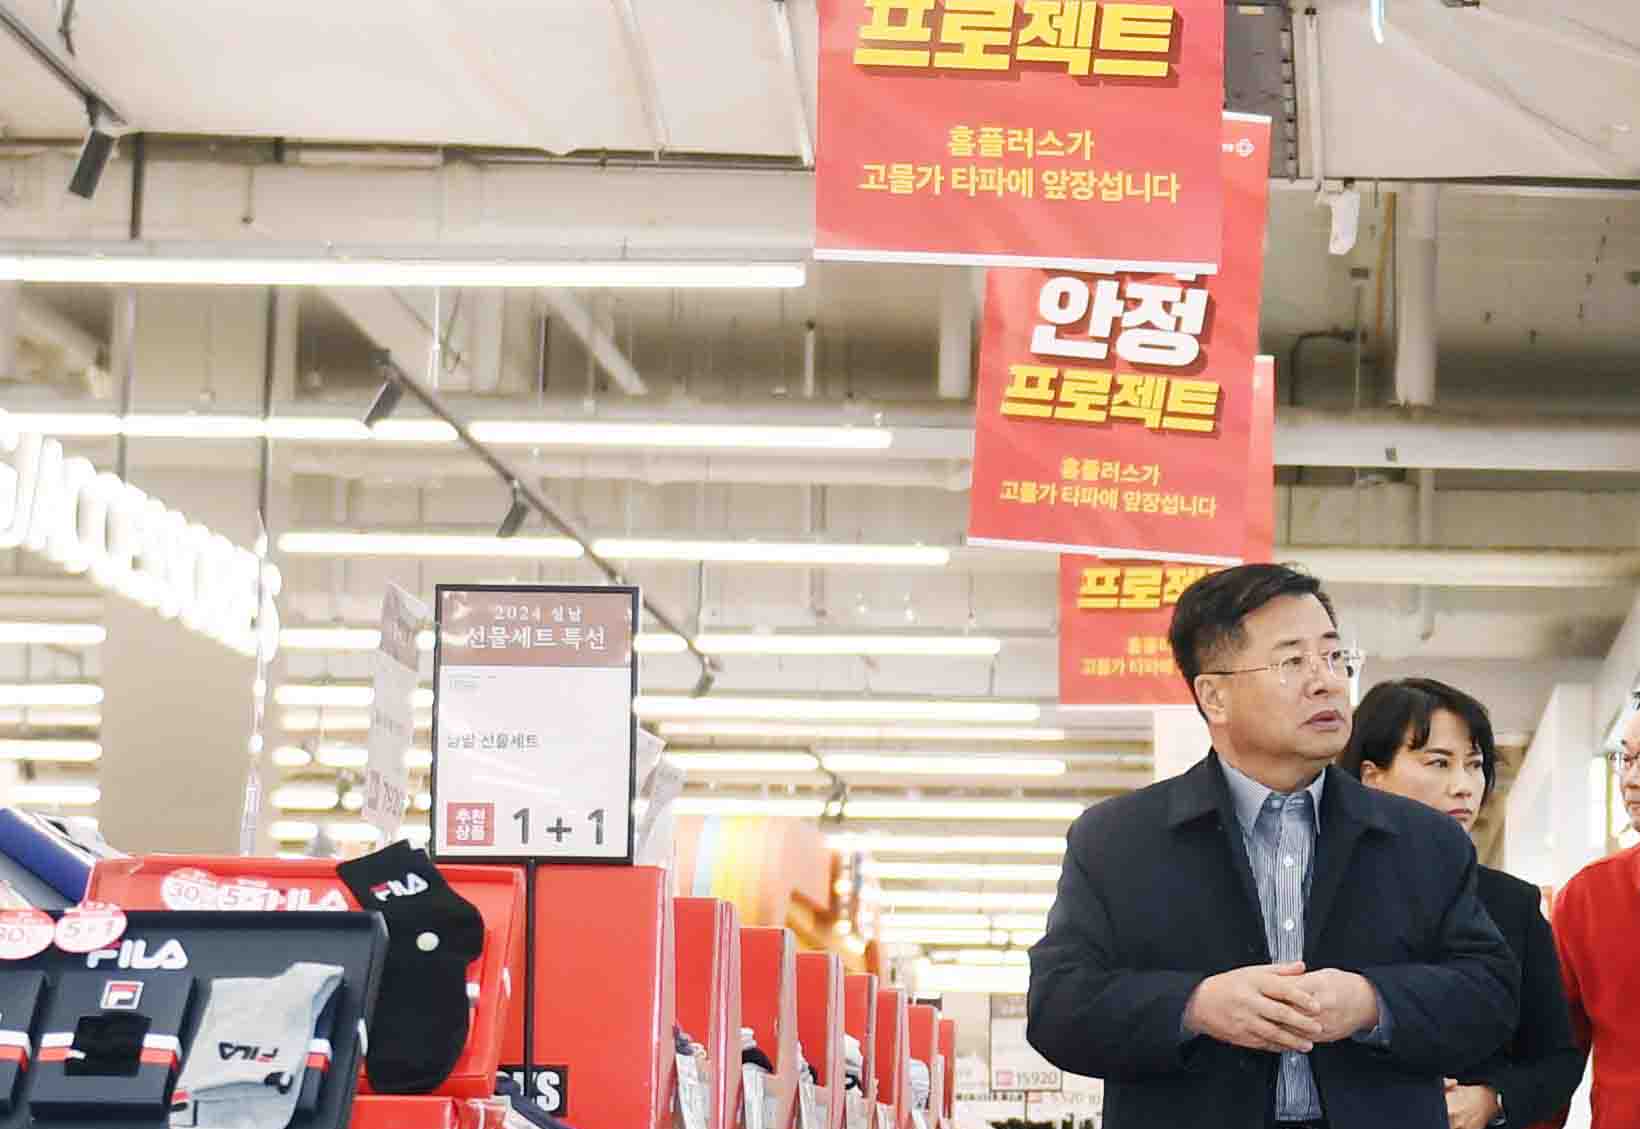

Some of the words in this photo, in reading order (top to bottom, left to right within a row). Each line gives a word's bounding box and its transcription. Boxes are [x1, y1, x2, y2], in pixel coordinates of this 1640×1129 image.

[854, 0, 1176, 78] 프로젝트
[948, 126, 1095, 160] 홈플러스가
[859, 163, 944, 196] 고물가
[951, 167, 1033, 199] 타파에
[1041, 168, 1180, 203] 앞장섭니다
[1030, 276, 1209, 367] 안정
[1000, 365, 1220, 433] 프로젝트
[1060, 456, 1160, 487] 홈플러스가
[999, 480, 1058, 505] 고물가
[1061, 485, 1119, 510] 타파에
[1123, 490, 1217, 518] 앞장섭니다
[495, 604, 541, 621] 2024
[465, 625, 561, 651] 선물세트
[562, 625, 608, 651] 특선
[481, 732, 540, 750] 선물세트
[370, 870, 430, 903] FILA
[217, 1040, 282, 1064] FILA
